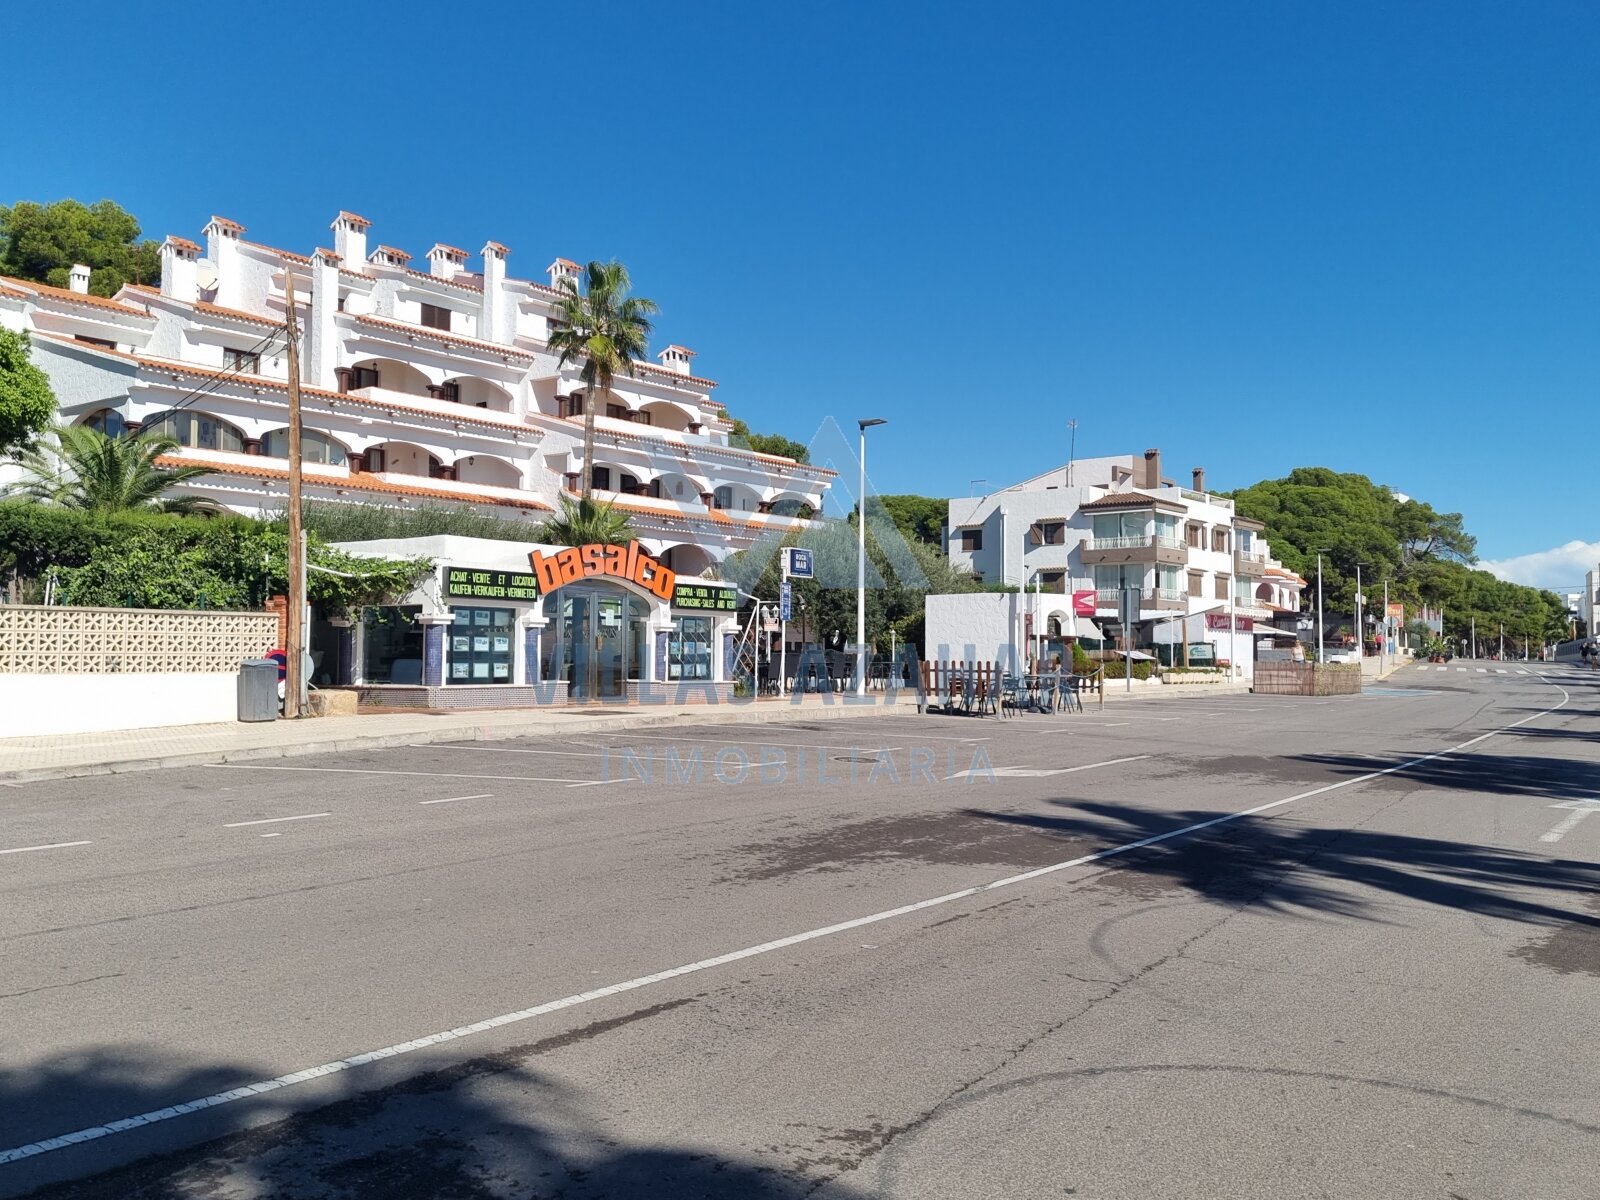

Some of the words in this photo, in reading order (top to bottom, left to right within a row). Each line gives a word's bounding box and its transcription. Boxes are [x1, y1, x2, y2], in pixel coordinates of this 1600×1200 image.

[530, 539, 676, 600] basalco
[450, 571, 467, 582] ACHAT
[472, 573, 491, 584] VENTE
[498, 575, 506, 585] ET
[511, 576, 536, 587] LOCATION
[711, 589, 716, 599] Y
